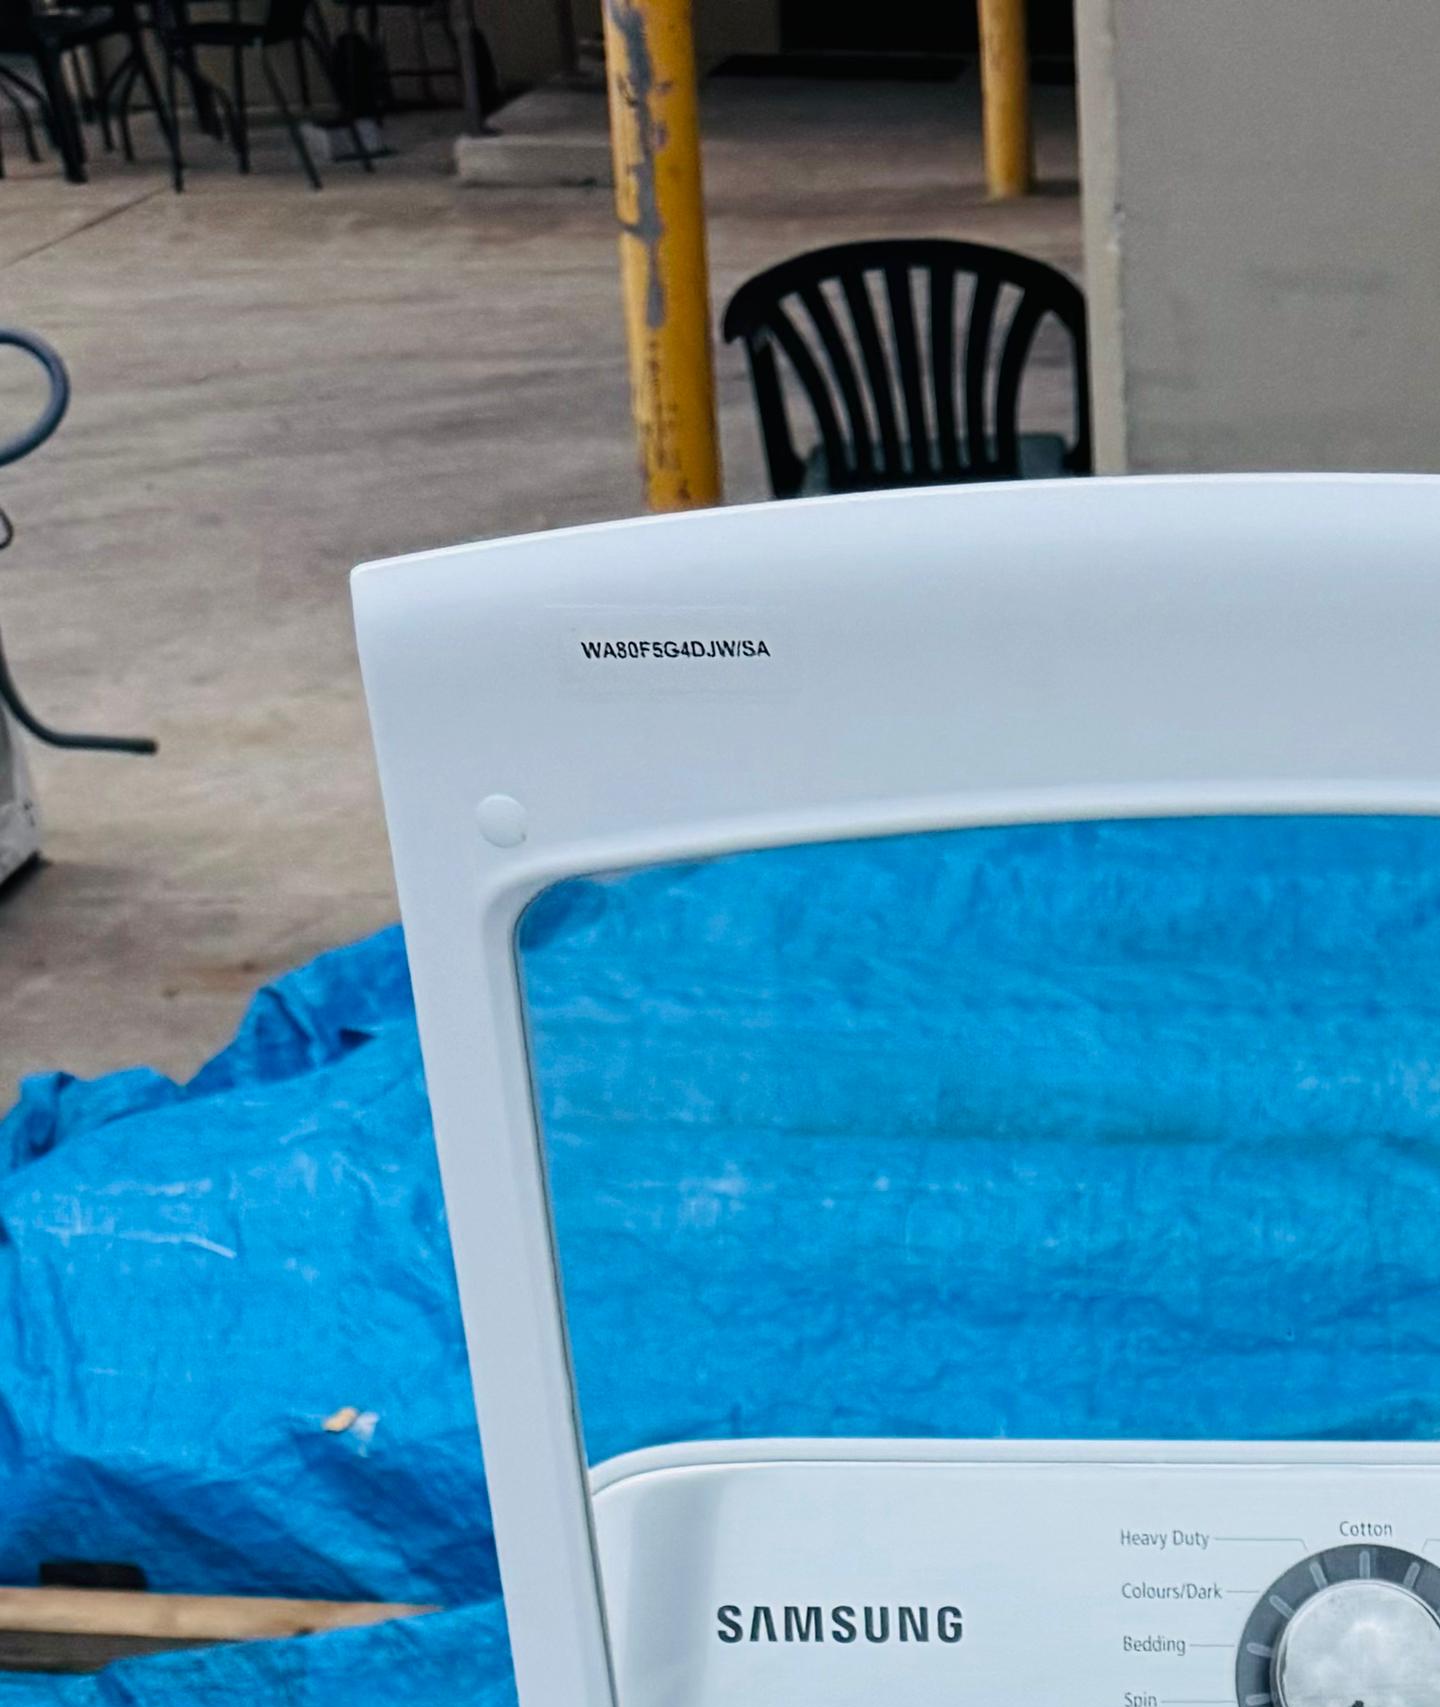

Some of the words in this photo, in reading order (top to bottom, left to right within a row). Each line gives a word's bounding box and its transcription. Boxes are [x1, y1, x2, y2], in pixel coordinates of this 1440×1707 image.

[1339, 1520, 1393, 1537] Cotton
[1120, 1529, 1166, 1549] Heavy
[1172, 1530, 1210, 1550] Duty
[1121, 1582, 1223, 1600] Colours/Dark
[717, 1605, 963, 1643] SAMSUNG
[1123, 1635, 1186, 1656] Bedding
